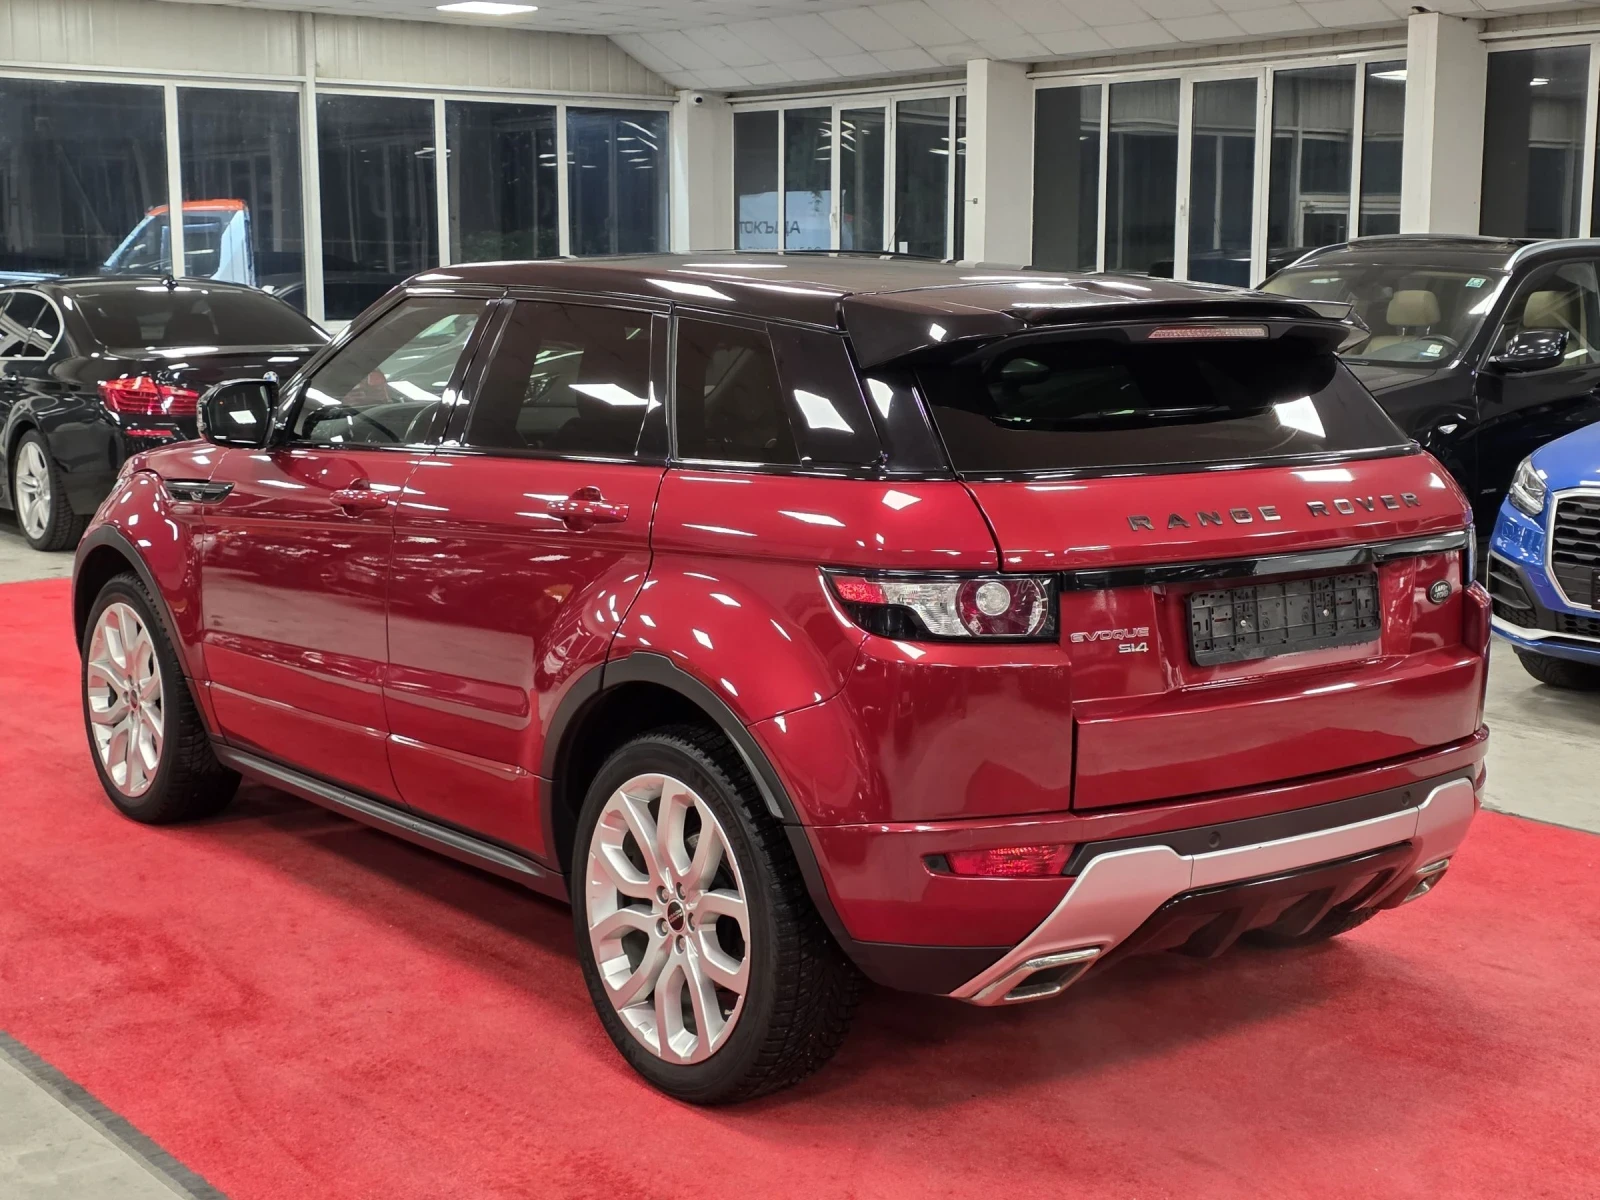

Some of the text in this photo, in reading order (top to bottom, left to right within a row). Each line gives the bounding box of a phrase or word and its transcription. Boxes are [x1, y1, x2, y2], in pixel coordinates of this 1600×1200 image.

[1127, 492, 1421, 531] RANGE ROVER
[1069, 626, 1150, 643] EVOQUE
